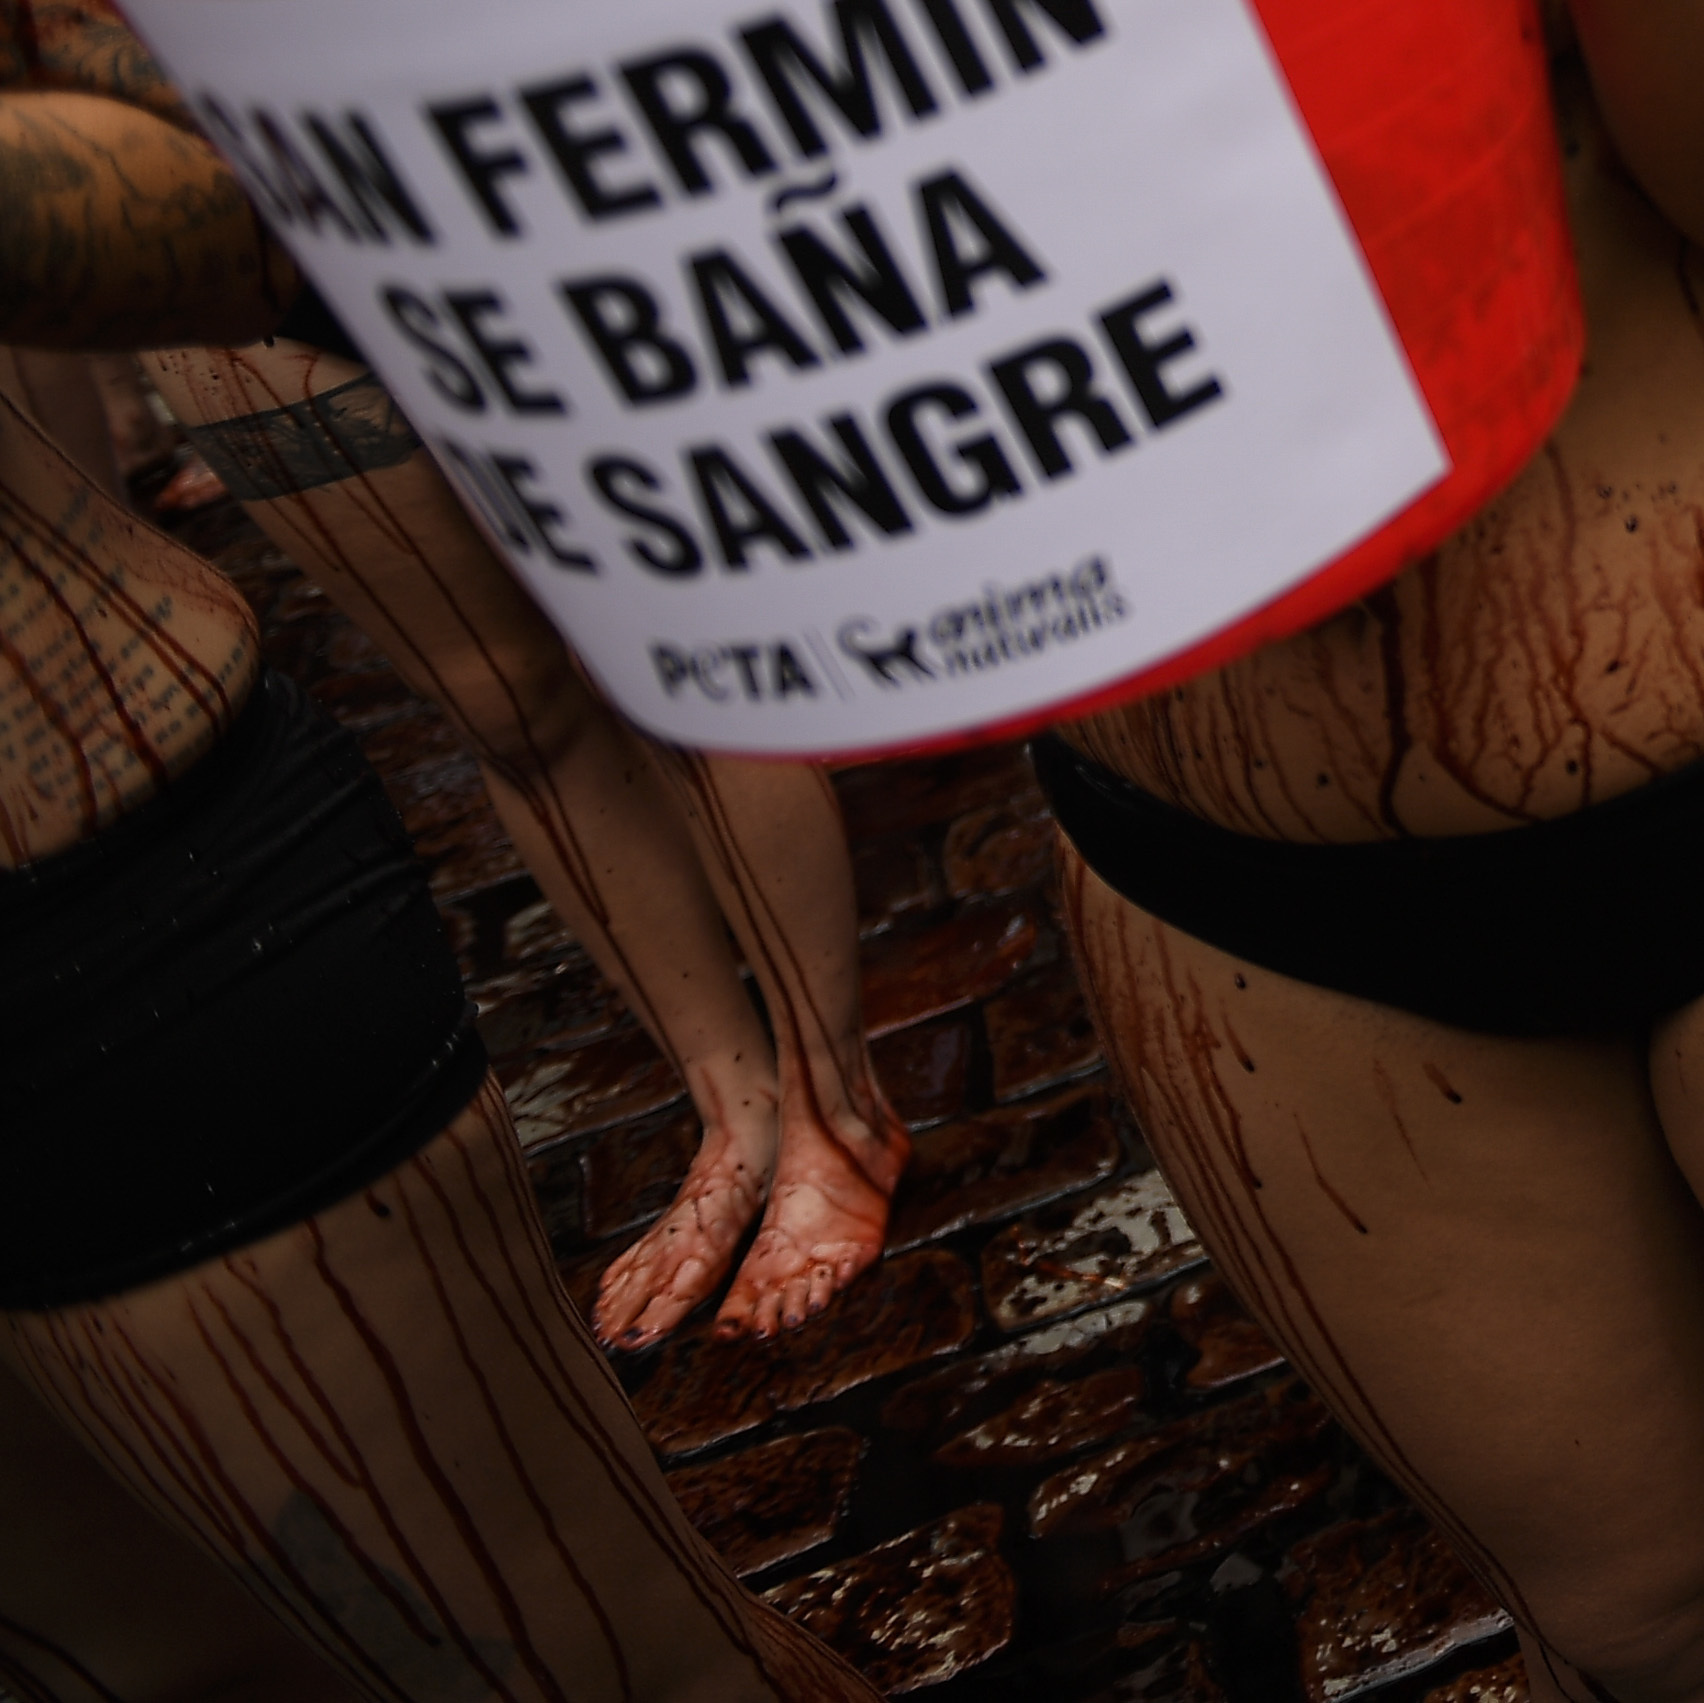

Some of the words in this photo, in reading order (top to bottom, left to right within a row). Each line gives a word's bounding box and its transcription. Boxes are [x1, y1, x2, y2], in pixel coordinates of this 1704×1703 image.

[380, 284, 568, 418] SE
[553, 164, 1048, 412] BAÑA
[587, 277, 1228, 584] SANGRE
